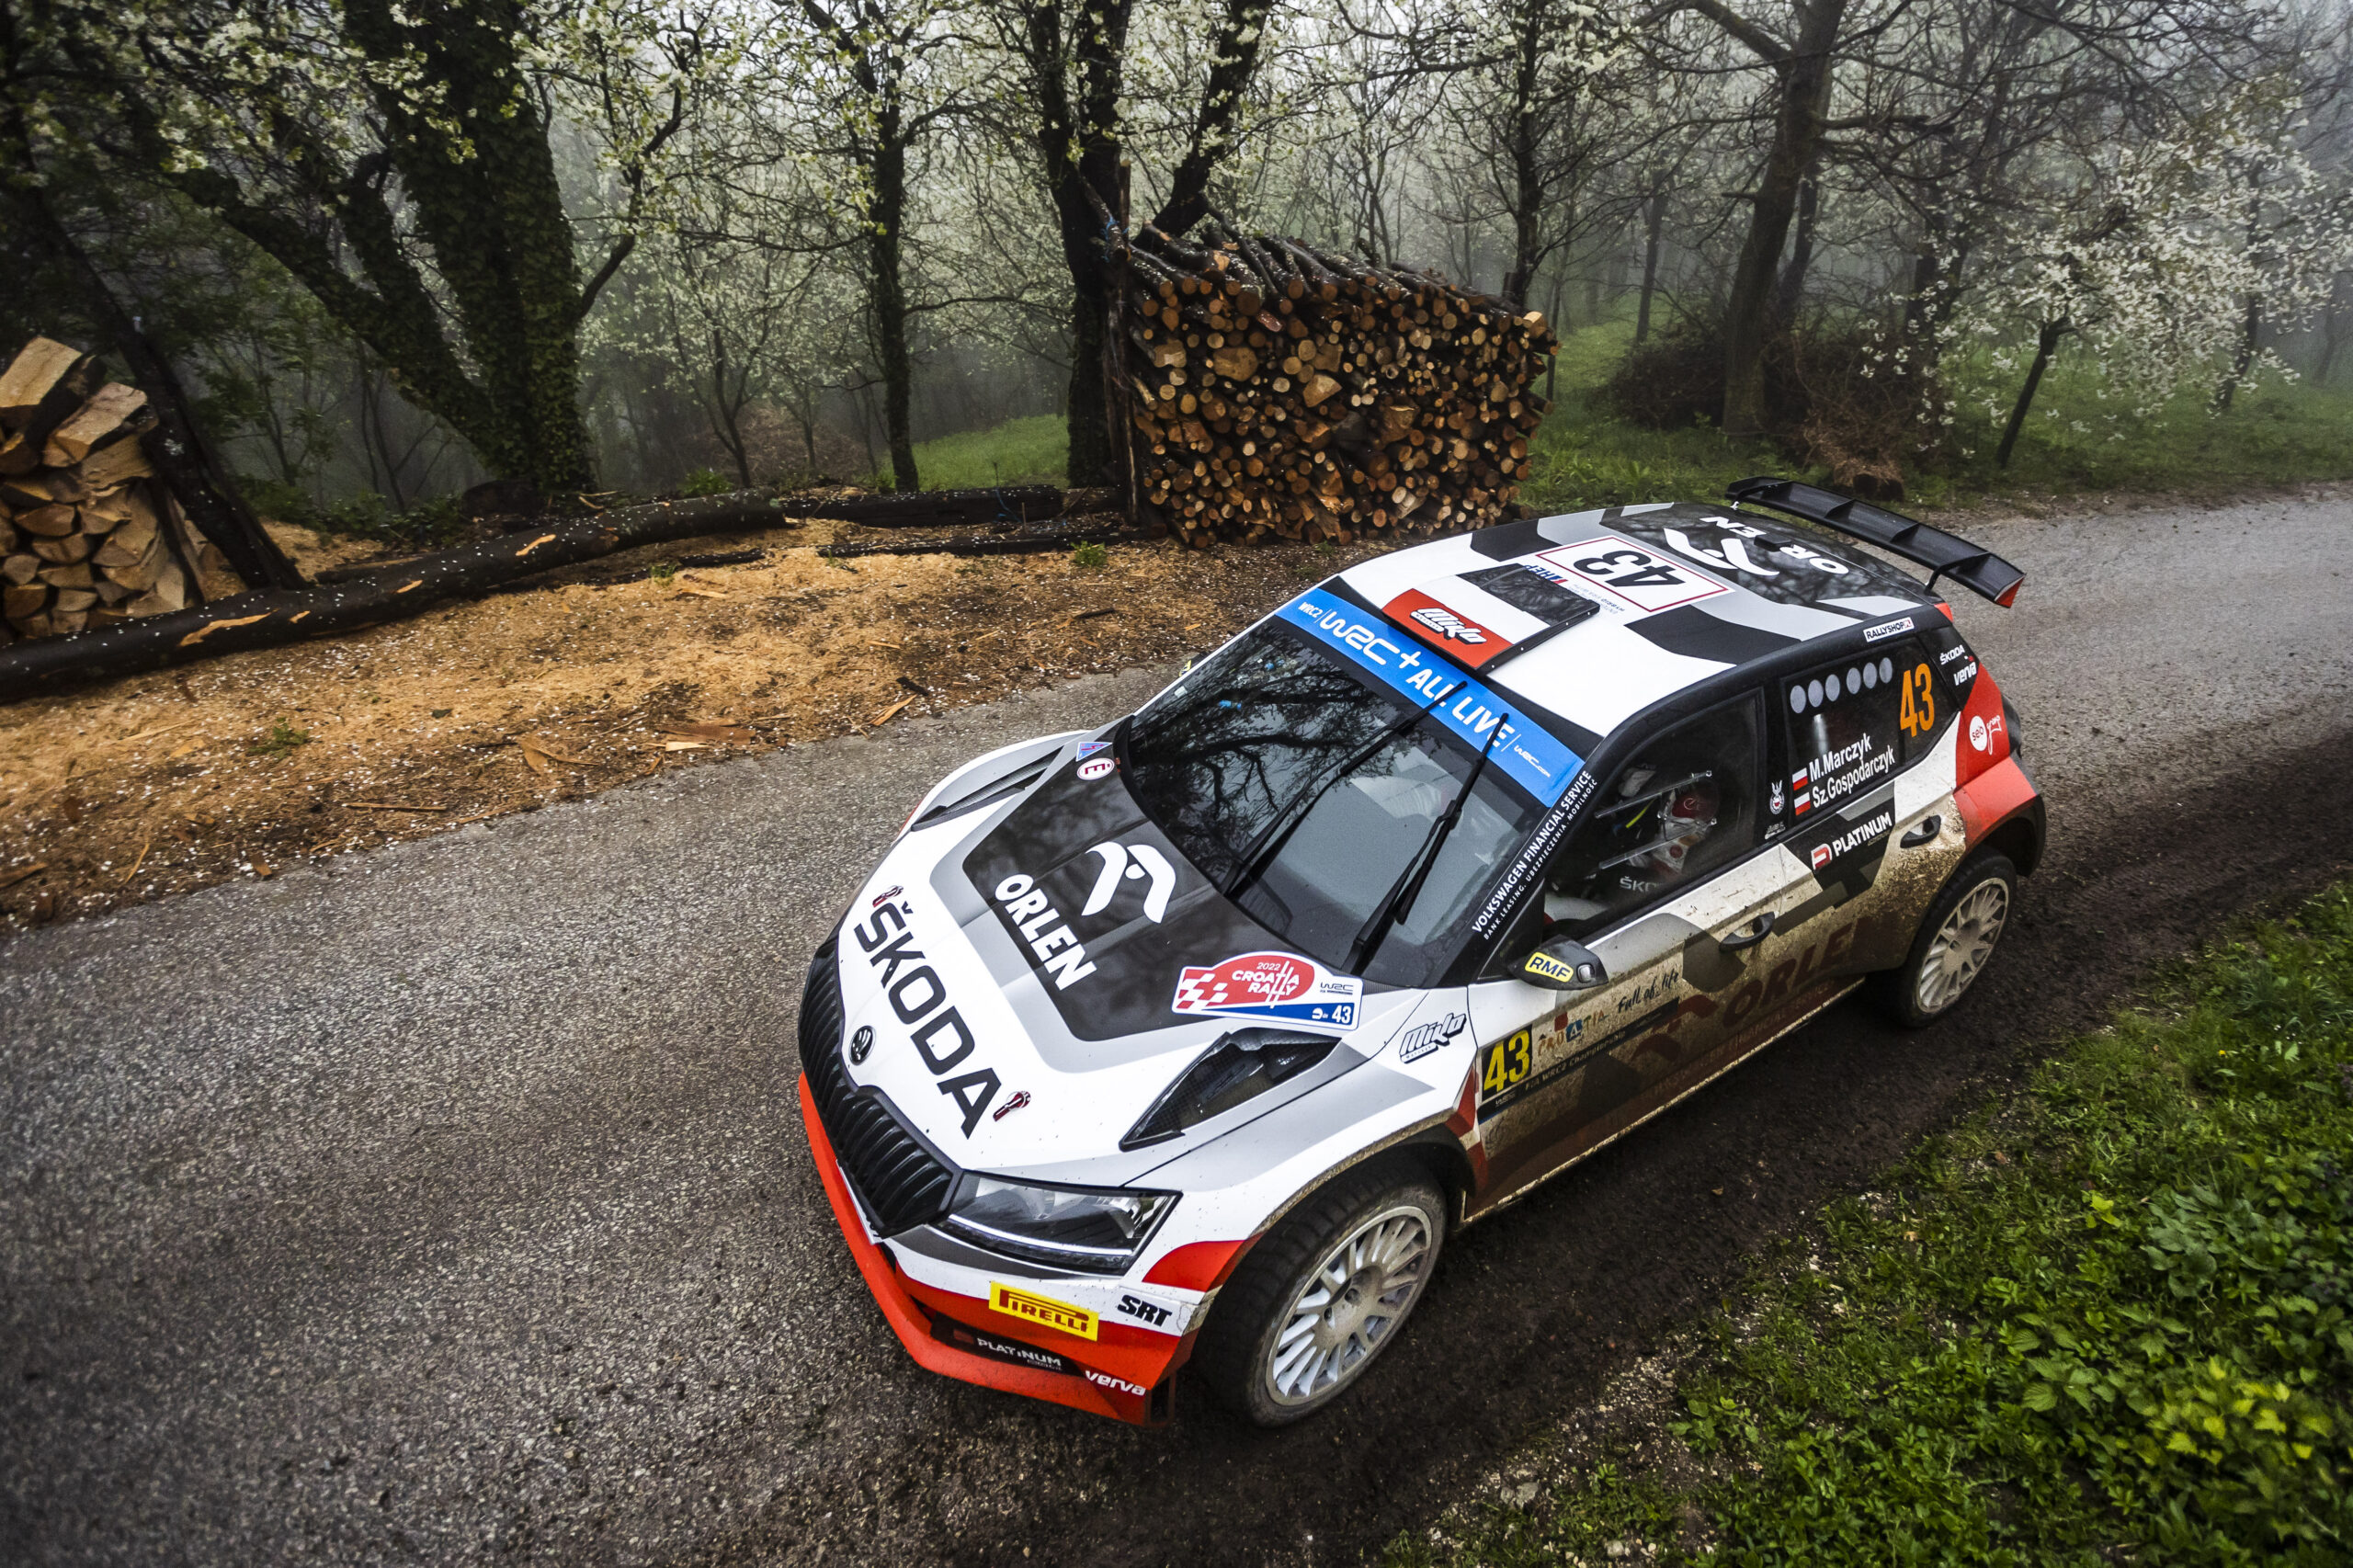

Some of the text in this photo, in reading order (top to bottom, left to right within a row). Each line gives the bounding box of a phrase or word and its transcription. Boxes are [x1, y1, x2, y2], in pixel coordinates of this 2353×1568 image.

[1699, 516, 1849, 575] OREN
[1573, 550, 1686, 588] 43
[1298, 601, 1322, 619] WRC2
[1451, 696, 1516, 748] LIVE
[1939, 643, 1965, 665] ŠKODA
[1953, 660, 1977, 687] verva
[1899, 662, 1936, 738] 43
[1809, 733, 1872, 782] M.Marczyk
[1812, 744, 1895, 809] Sz.Gospodarczyk
[1472, 770, 1592, 935] VOLKSWAGEN FINANCIAL SERVICE
[1832, 812, 1893, 858] PLATINUM
[995, 873, 1097, 991] ORLEN
[1232, 969, 1300, 987] CROATIA
[1256, 961, 1281, 971] 2022
[1529, 956, 1571, 977] RMF
[1722, 915, 1880, 1030] ORLE
[1247, 982, 1298, 996] RALLY
[1320, 982, 1355, 992] WRC
[853, 901, 1002, 1141] ŠKODA
[1332, 1005, 1351, 1025] 43
[1483, 1029, 1530, 1093] 43
[999, 1289, 1090, 1333] PIRELLI
[1116, 1294, 1173, 1327] SRT
[976, 1336, 1063, 1367] PLATINUM
[1085, 1369, 1147, 1397] verva
